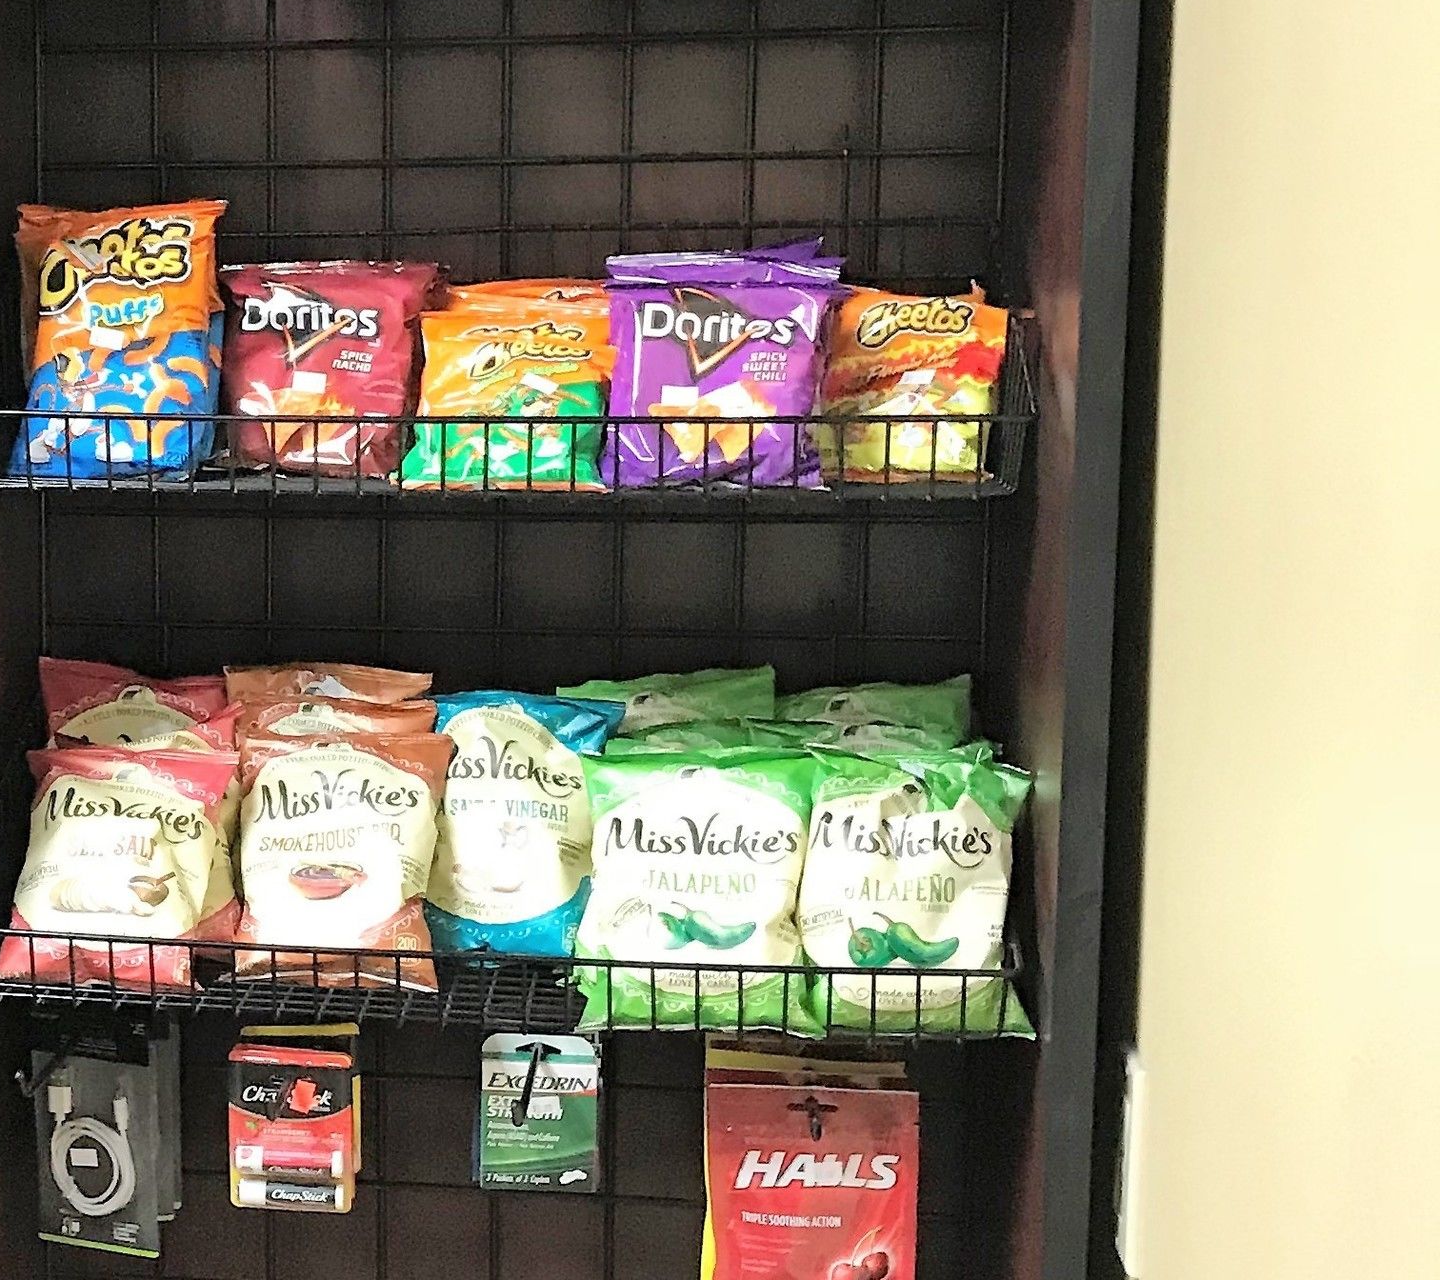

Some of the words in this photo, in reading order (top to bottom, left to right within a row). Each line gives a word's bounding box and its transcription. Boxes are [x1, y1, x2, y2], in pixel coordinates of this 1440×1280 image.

[241, 296, 382, 338] Doritos
[642, 301, 796, 345] Doritos
[858, 298, 973, 348] Cheetos
[332, 359, 373, 373] NACHO
[340, 350, 374, 364] SPICY
[741, 361, 788, 372] SWEET
[749, 350, 789, 363] SPICY
[752, 370, 787, 382] CHILI
[446, 755, 486, 780] iss
[478, 735, 582, 799] Vickie's
[44, 787, 109, 831] Miss
[253, 779, 320, 824] Miss
[505, 800, 569, 822] VINEGAR
[605, 816, 686, 857] Miss
[679, 812, 799, 864] Vickie's
[881, 811, 993, 870] Vickie's
[397, 936, 417, 949] 200
[271, 1188, 329, 1203] ChapStick
[741, 1211, 768, 1226] TRIPLE
[768, 1213, 810, 1228] SOOTHING
[810, 1216, 842, 1228] ACTION
